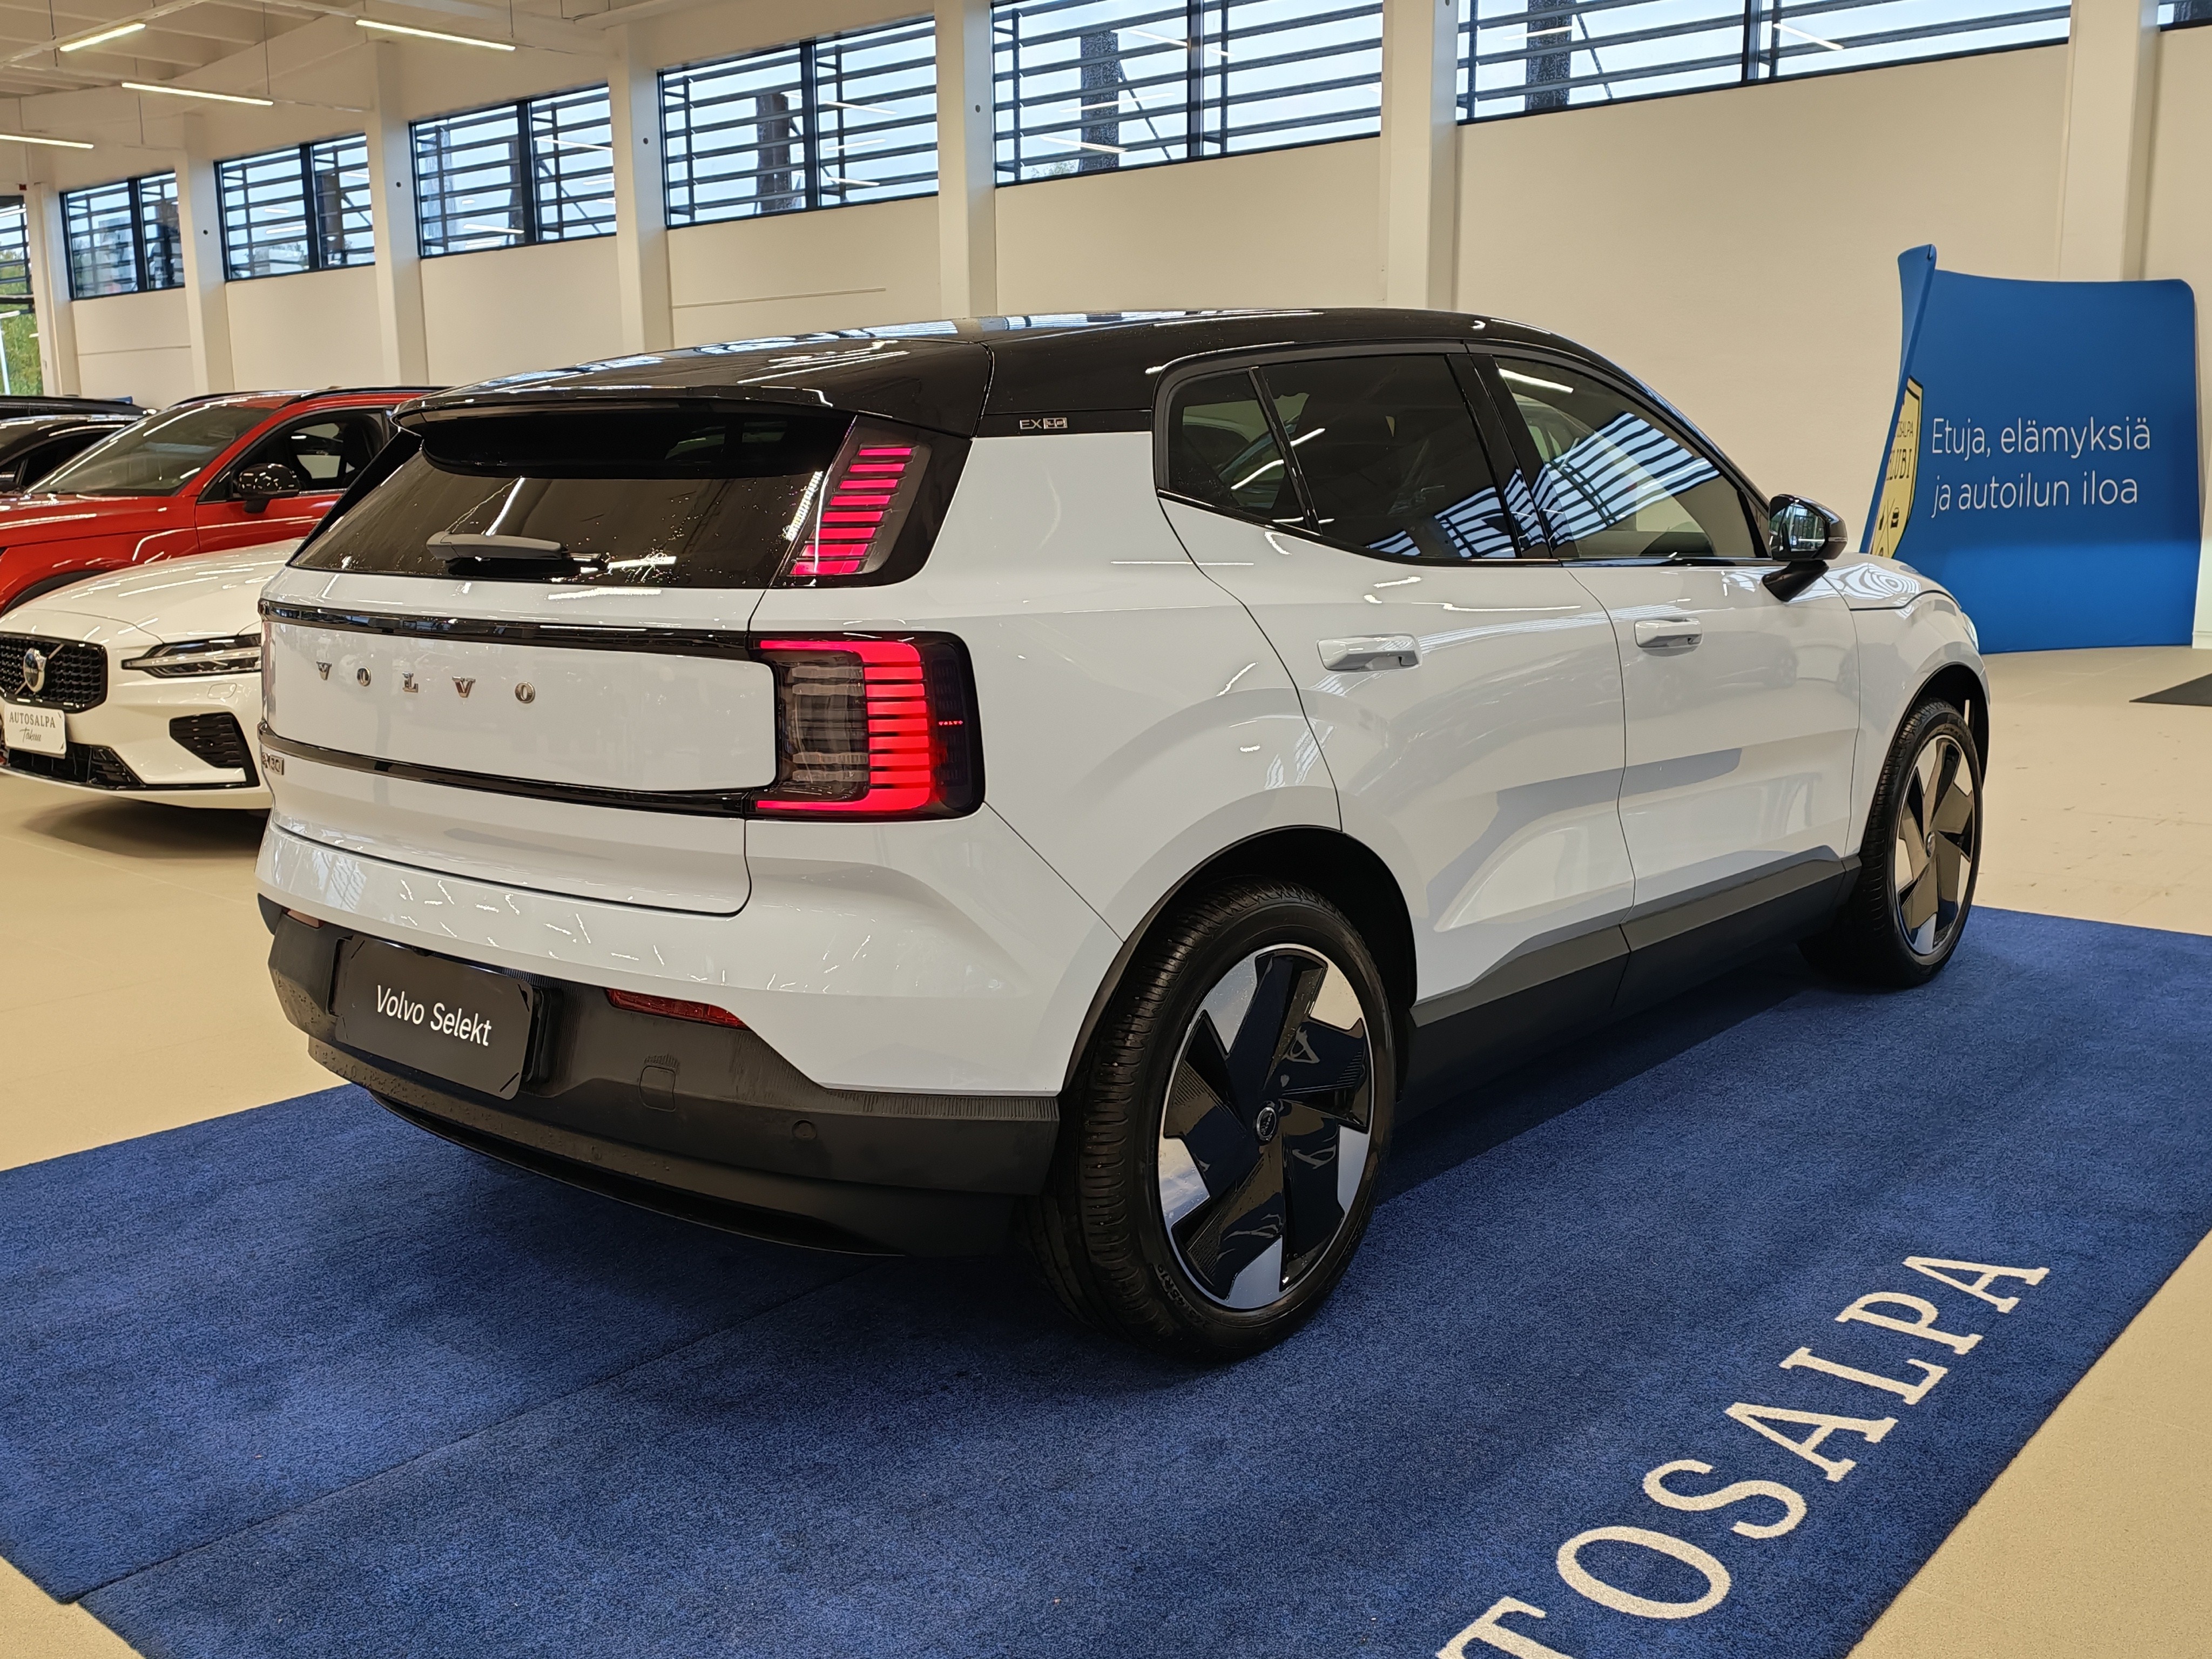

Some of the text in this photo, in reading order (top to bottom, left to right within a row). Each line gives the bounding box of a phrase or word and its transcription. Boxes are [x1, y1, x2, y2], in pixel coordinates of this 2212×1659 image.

[1932, 416, 2151, 461] Etuja, elämyksiä
[1887, 448, 1913, 481] LUBI
[1931, 470, 2138, 518] ja autoilun iloa
[316, 660, 536, 704] VOLVO
[9, 711, 56, 728] AUTOSALPA
[376, 984, 493, 1047] Volvo Selekt
